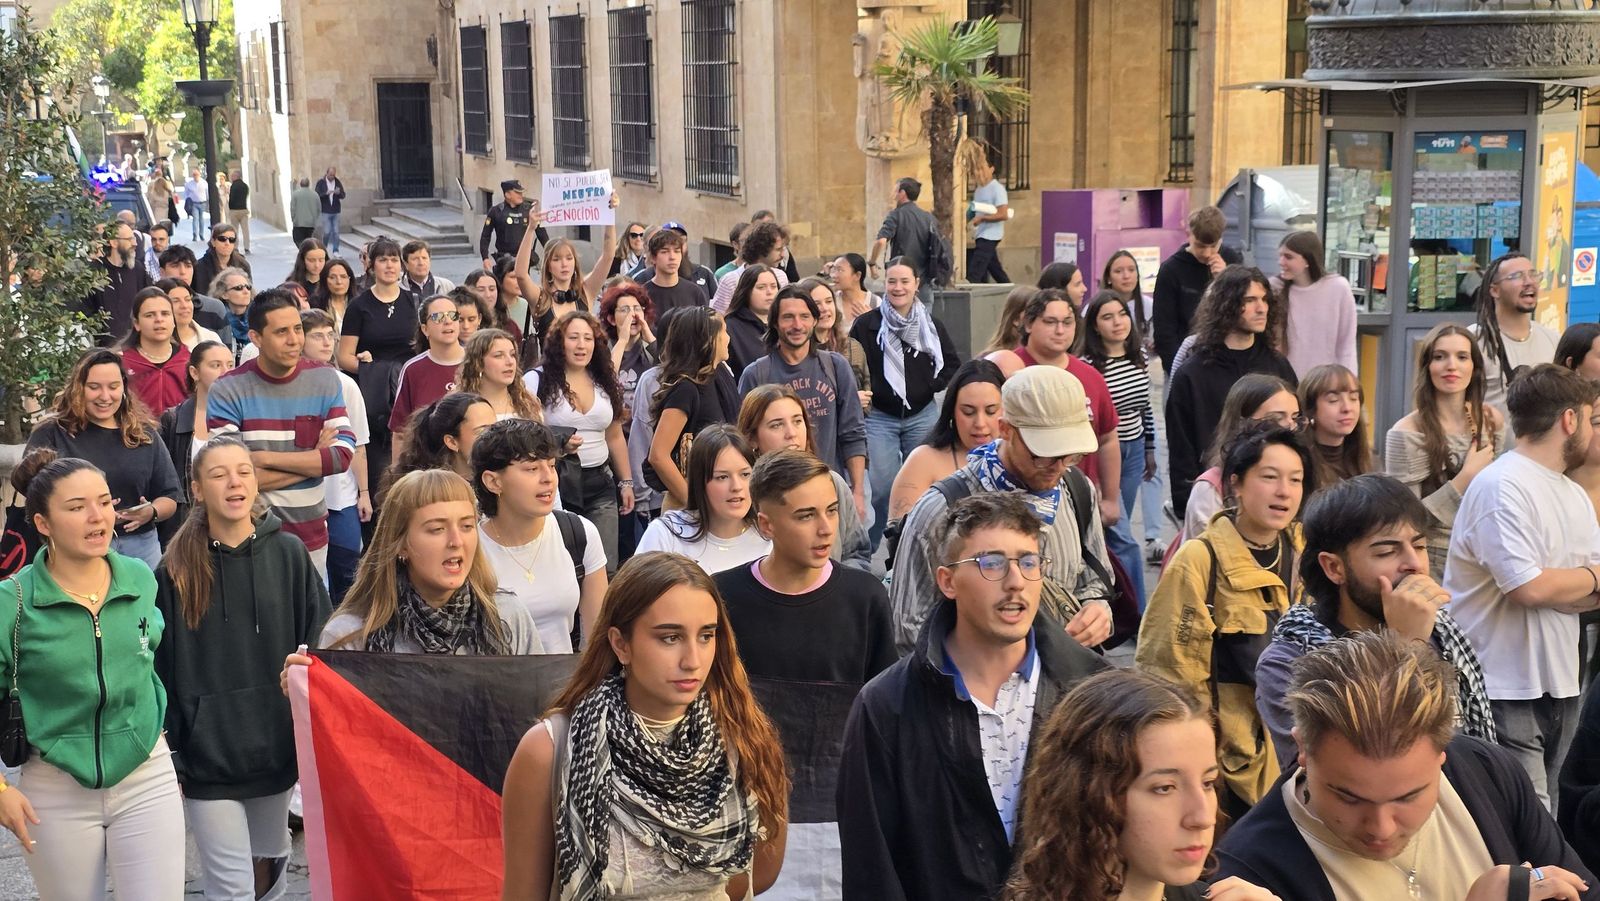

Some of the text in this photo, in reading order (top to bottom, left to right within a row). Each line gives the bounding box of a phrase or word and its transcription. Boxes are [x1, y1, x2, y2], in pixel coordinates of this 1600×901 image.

[548, 177, 560, 188] NO
[562, 187, 605, 200] NEUTRO
[815, 380, 836, 402] INTO
